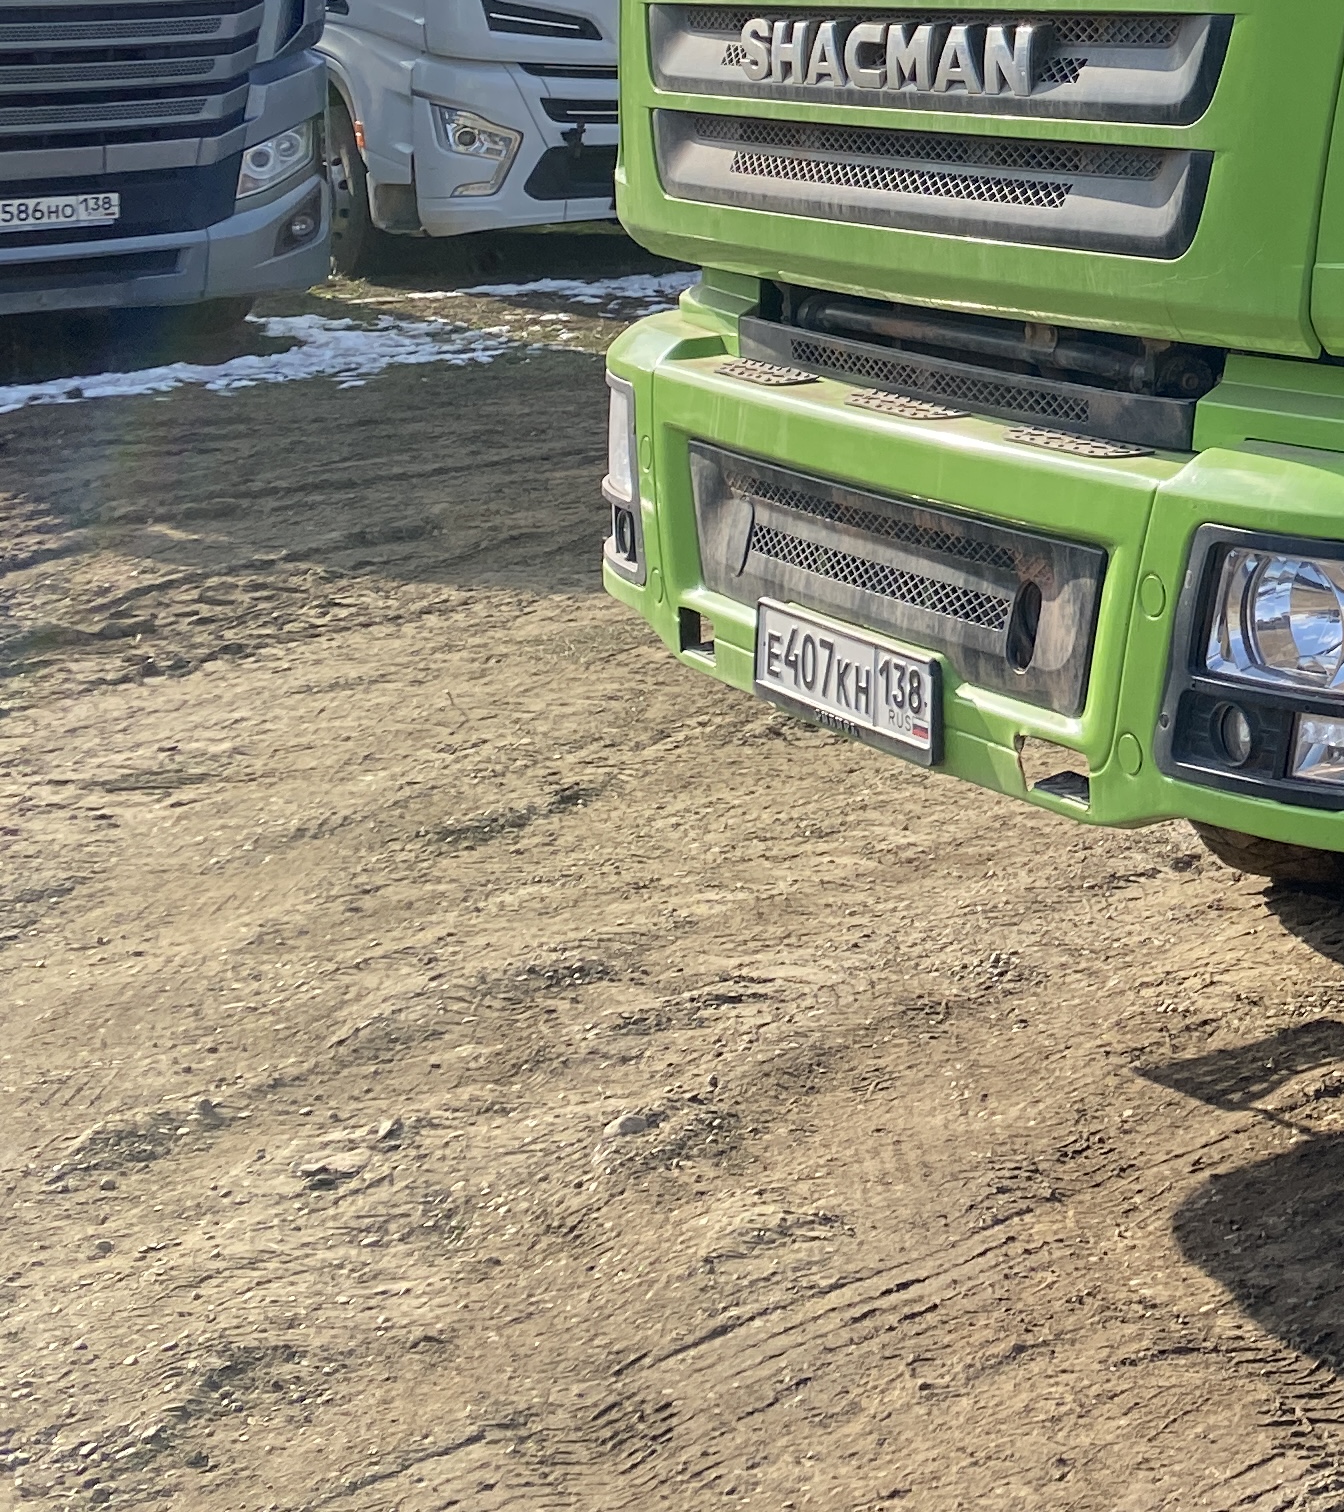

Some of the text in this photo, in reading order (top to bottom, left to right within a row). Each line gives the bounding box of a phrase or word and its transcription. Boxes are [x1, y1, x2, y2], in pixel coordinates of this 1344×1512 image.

[740, 17, 1042, 97] SHACMAN
[79, 195, 112, 212] 138
[878, 656, 923, 715] 138
[888, 708, 913, 732] RUS
